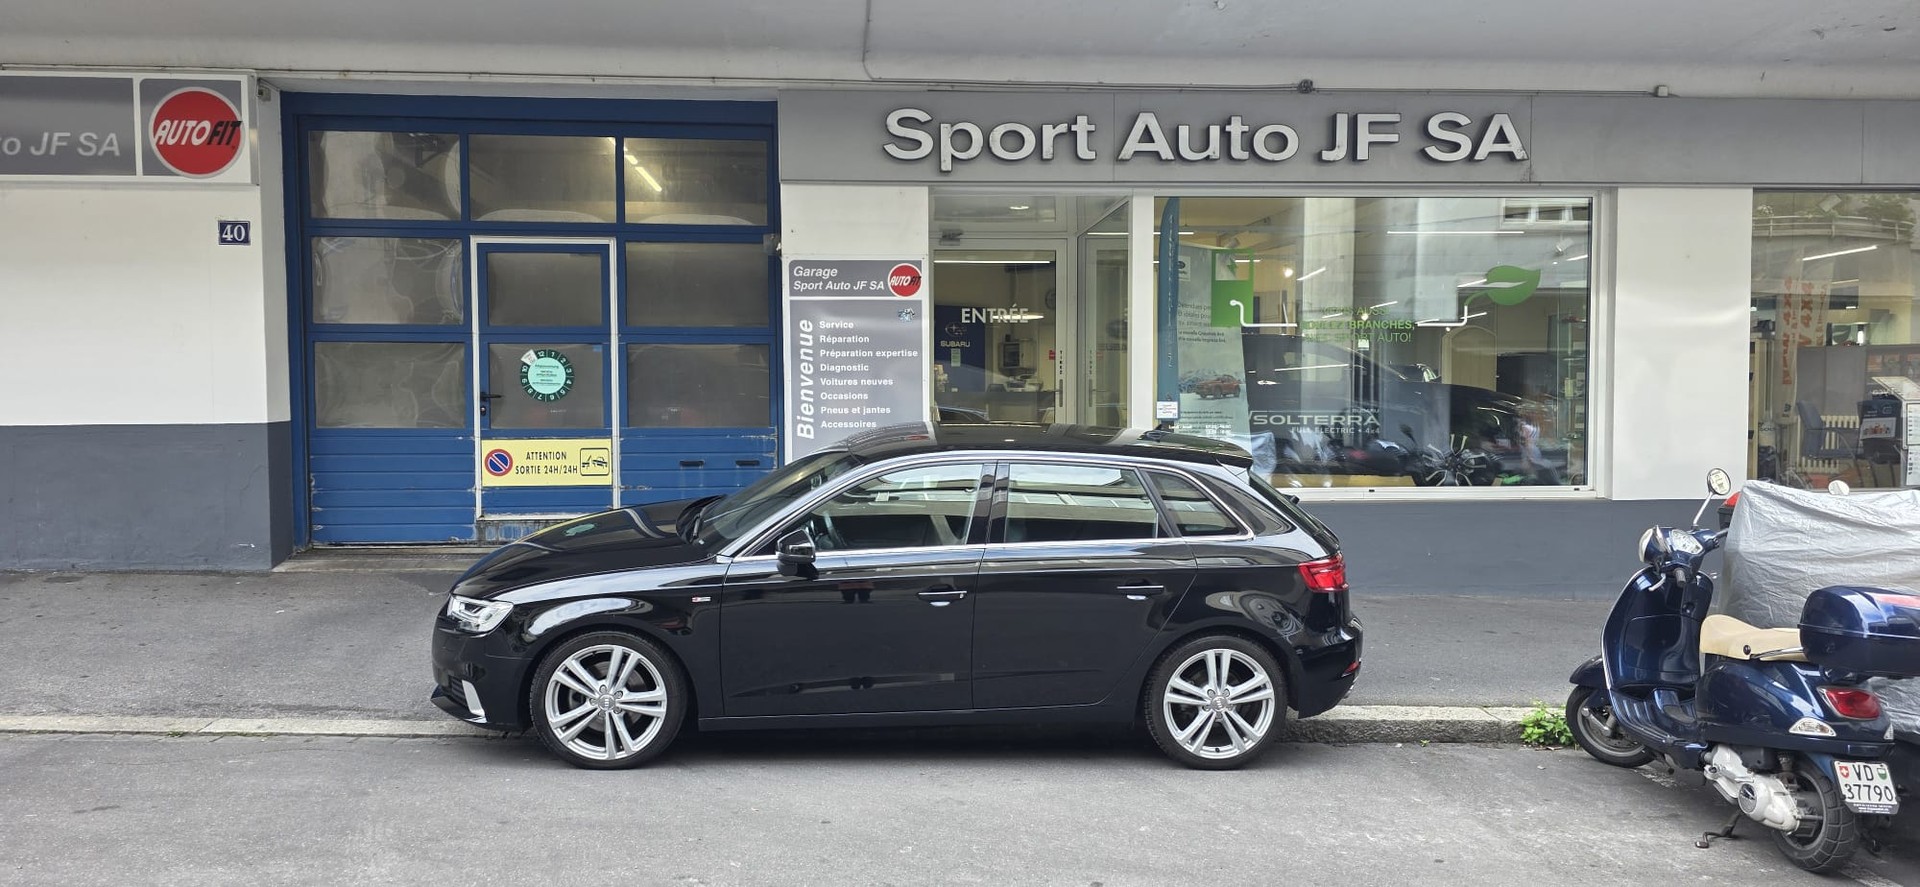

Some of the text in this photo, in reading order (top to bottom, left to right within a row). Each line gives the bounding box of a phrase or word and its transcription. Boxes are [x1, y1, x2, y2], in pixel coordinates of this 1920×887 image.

[154, 119, 242, 146] AUTOFIT
[0, 132, 121, 156] o JF SA
[883, 108, 1529, 172] Sport Auto JF SA
[222, 225, 245, 242] 40
[793, 266, 838, 280] Garage
[793, 281, 884, 292] Sport Auto JF SA
[961, 303, 1029, 324] ENTRÉE
[819, 320, 854, 330] Service
[819, 334, 870, 345] Réparation
[1377, 332, 1411, 343] AUTO!
[819, 349, 919, 360] Préparation expertise
[820, 363, 869, 374] Diagnostic
[797, 320, 815, 439] Bienvenue
[820, 377, 894, 387] Voitures neuves
[820, 391, 869, 401] Occasions
[820, 405, 891, 416] Pneus et jantes
[821, 420, 877, 429] Accessoires
[1253, 414, 1380, 426] SOLTERRA
[525, 451, 567, 461] ATTENTION
[515, 464, 578, 475] SORTIE 24H/24H
[1852, 764, 1874, 781] VD
[1845, 783, 1893, 802] 37790
